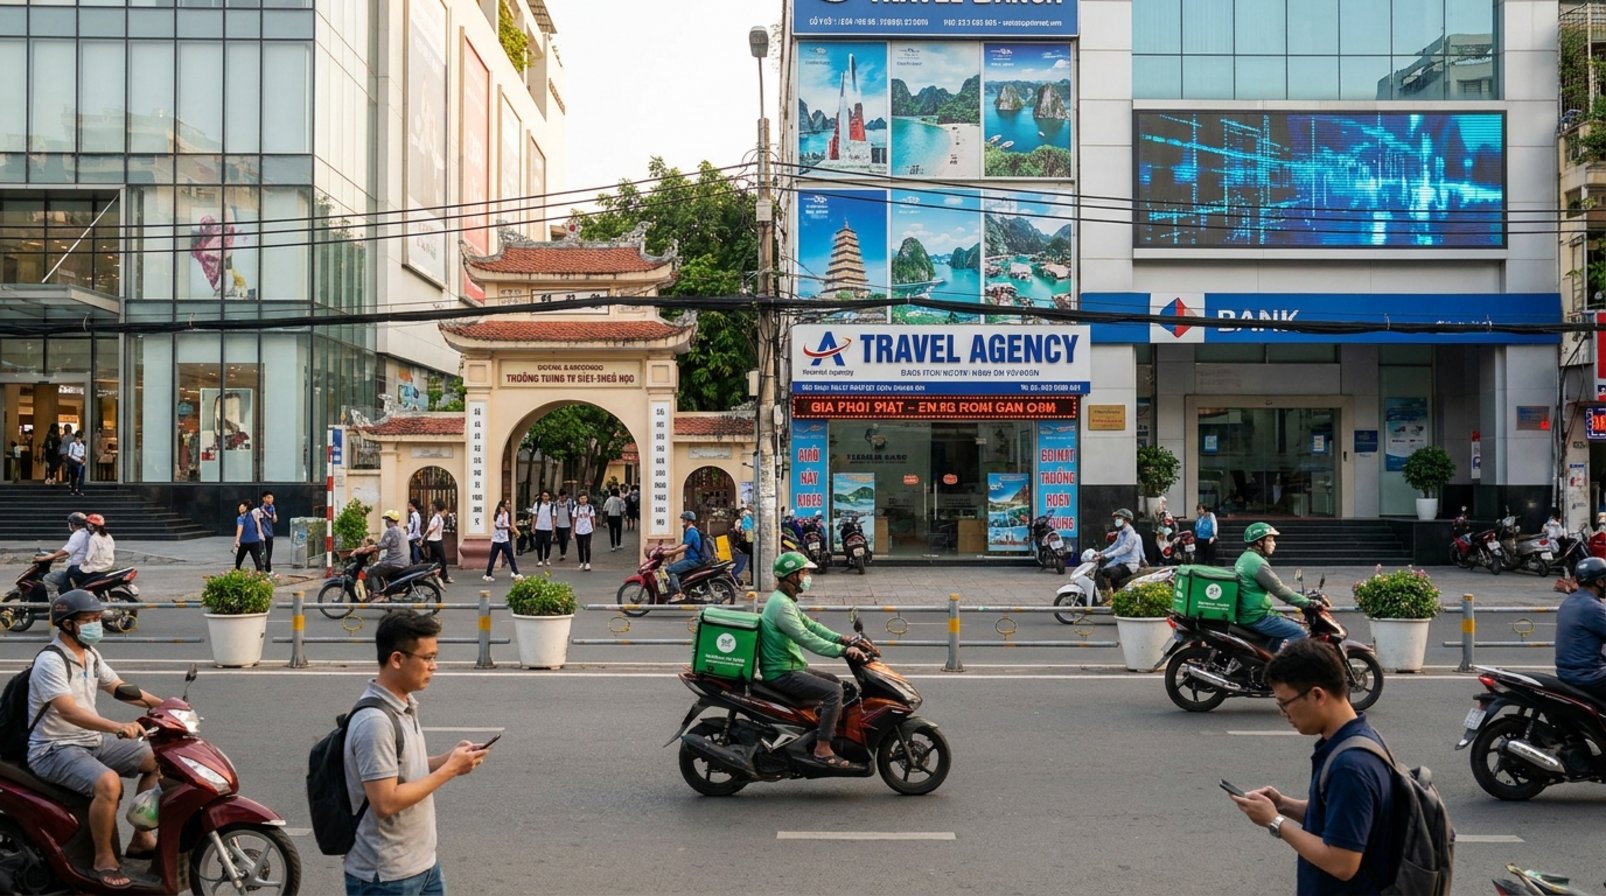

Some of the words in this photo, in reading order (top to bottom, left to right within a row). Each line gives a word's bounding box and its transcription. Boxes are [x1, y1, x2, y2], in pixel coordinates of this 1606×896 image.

[1217, 309, 1300, 332] BANK
[860, 334, 960, 364] TRAVEL
[969, 333, 1080, 364] AGENCY
[811, 402, 834, 413] GIA
[995, 402, 1024, 413] GAN
